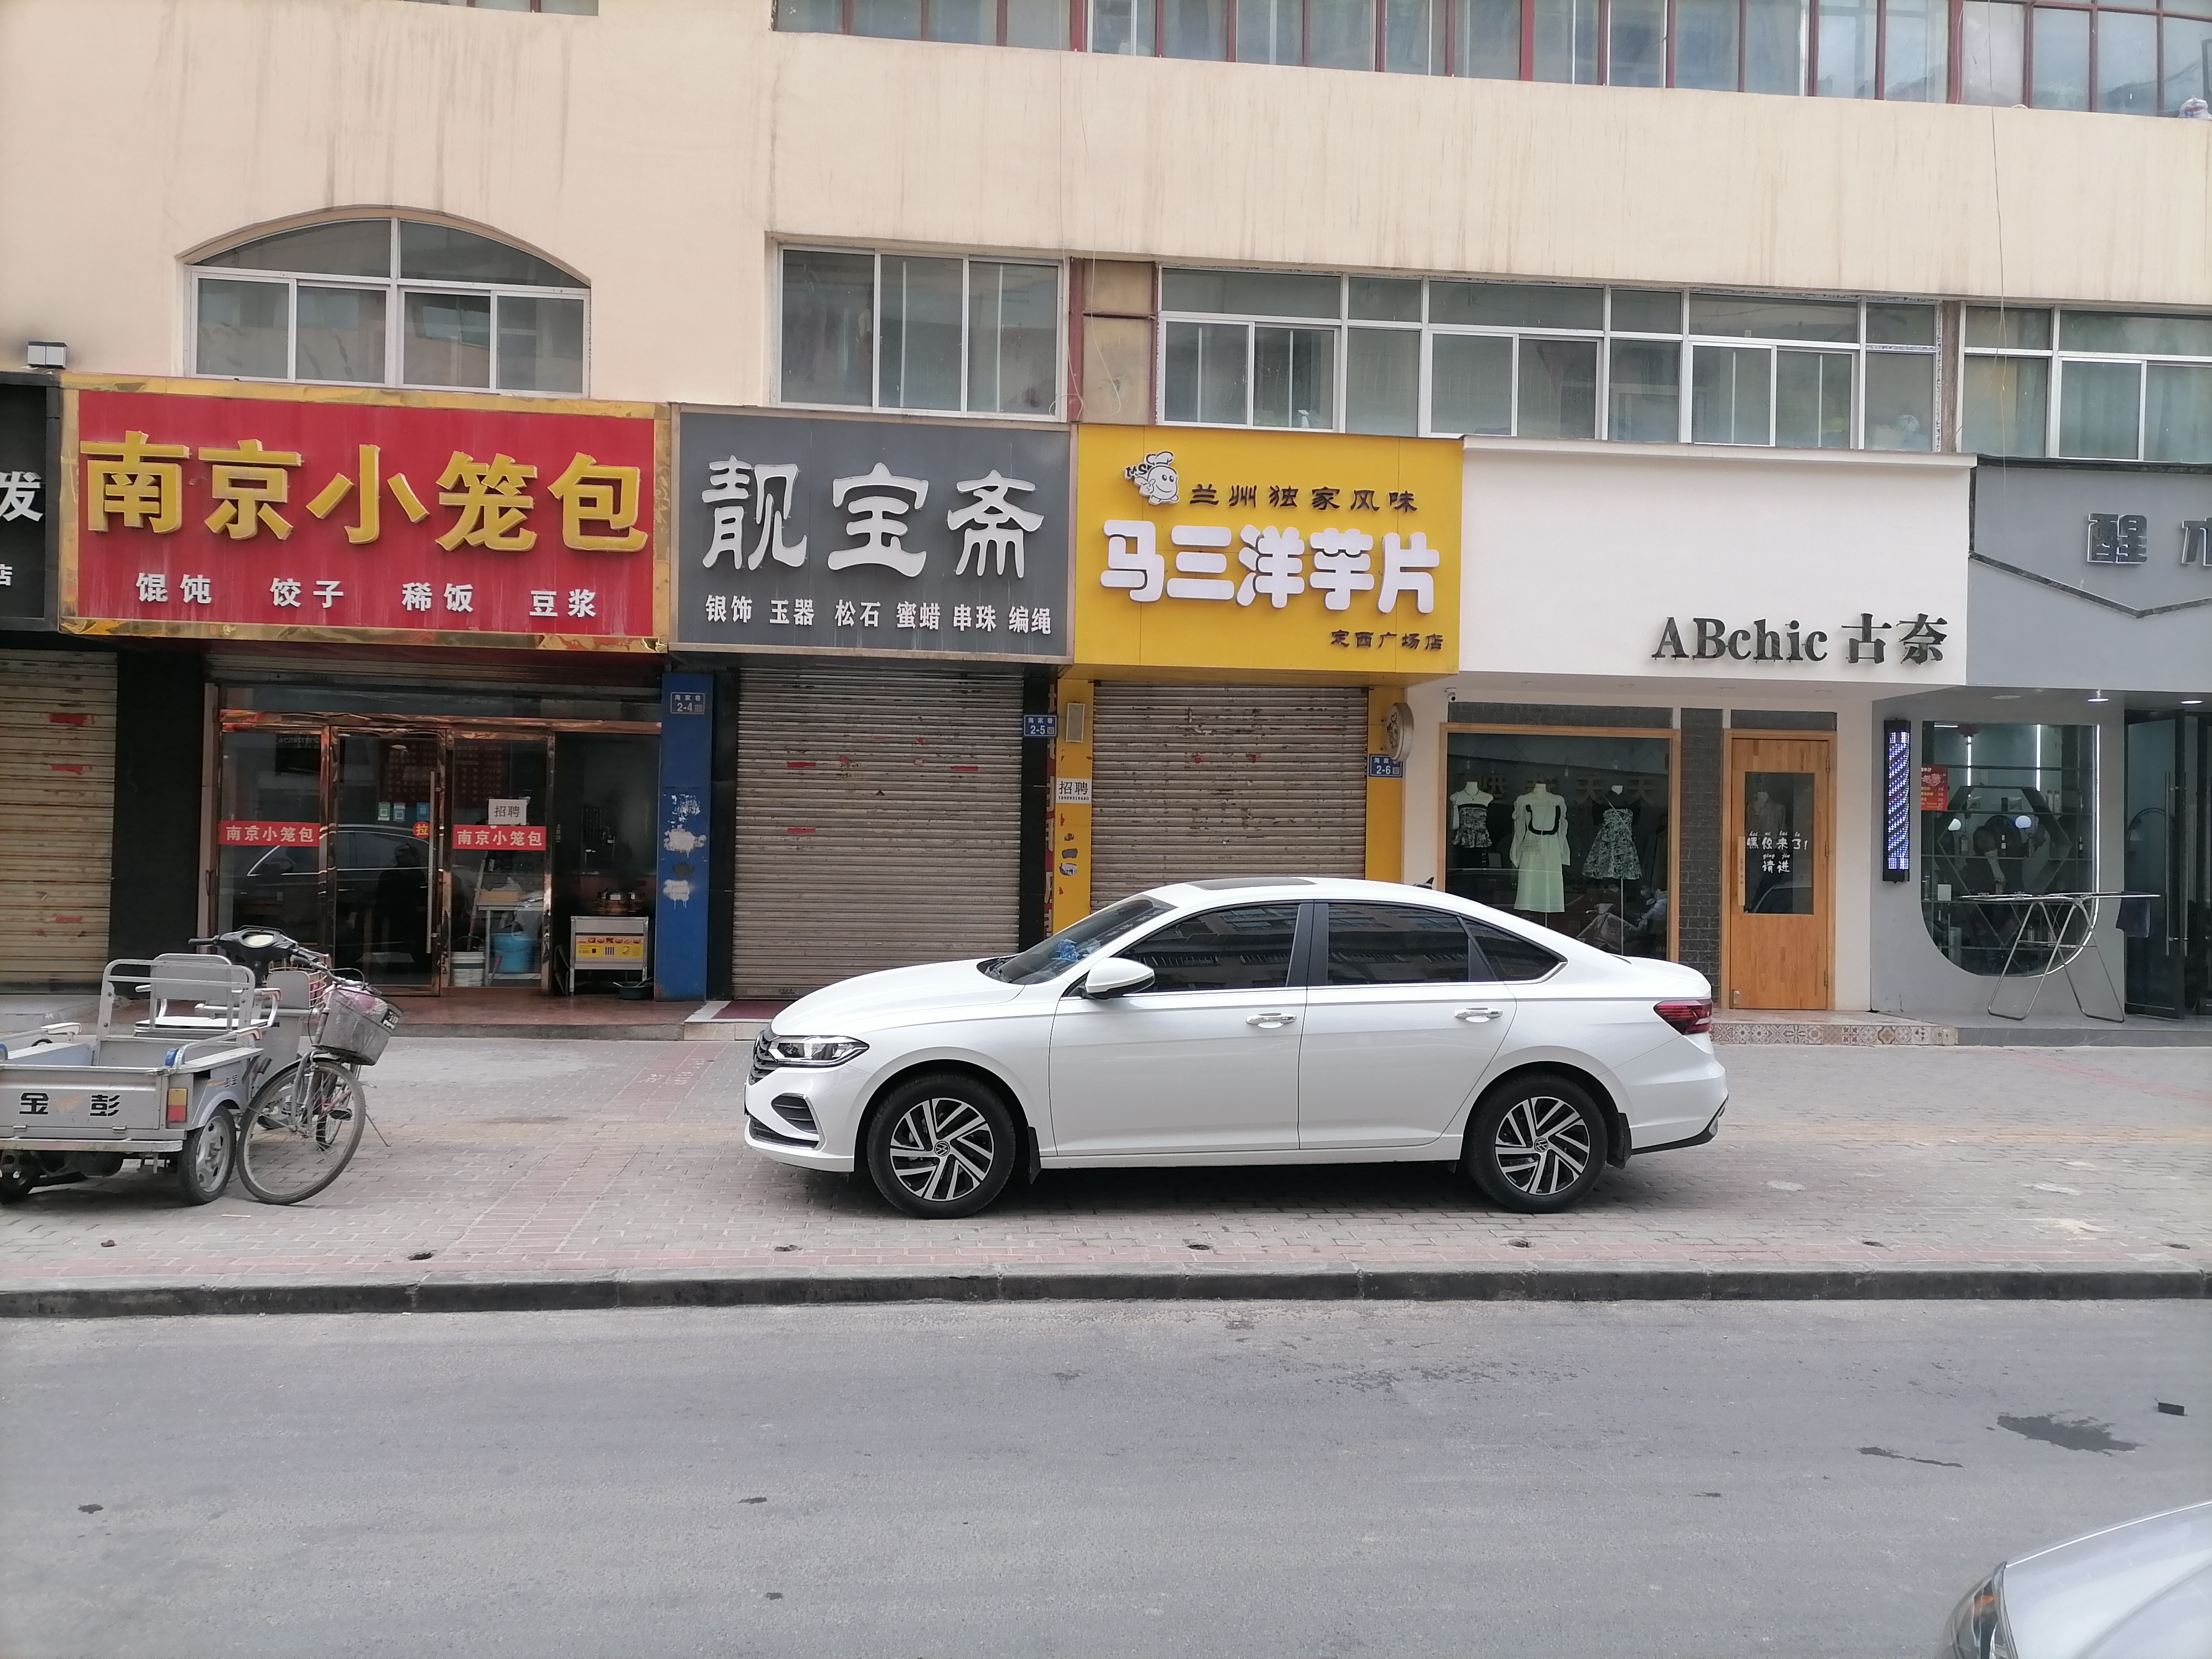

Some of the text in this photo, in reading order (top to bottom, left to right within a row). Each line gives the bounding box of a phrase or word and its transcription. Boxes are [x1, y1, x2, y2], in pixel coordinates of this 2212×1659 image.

[80, 430, 648, 552] 南京小笼包
[1189, 484, 1418, 513] 兰州独家风味
[701, 455, 1045, 578] 靓宝斋
[1100, 519, 1440, 614] 马三洋芋片
[136, 572, 596, 618] 馄饨 饺子 稀饭 豆浆
[705, 594, 1052, 635] 银饰 玉器 松石 蜜蜡 串珠 编绳
[1330, 629, 1444, 651] 定西广场店
[1651, 613, 1948, 665] ABchic 古奈
[677, 702, 692, 712] 2-4
[1030, 725, 1045, 734] 2-5
[1376, 765, 1391, 775] 2-6
[1058, 780, 1088, 795] 招聘
[494, 805, 520, 818] 招聘
[226, 825, 314, 842] 南京小笼包
[416, 824, 429, 836] 拉
[457, 830, 542, 846] 南京小笼包
[1762, 860, 1791, 874] 请进
[19, 1092, 121, 1117] 金彭
